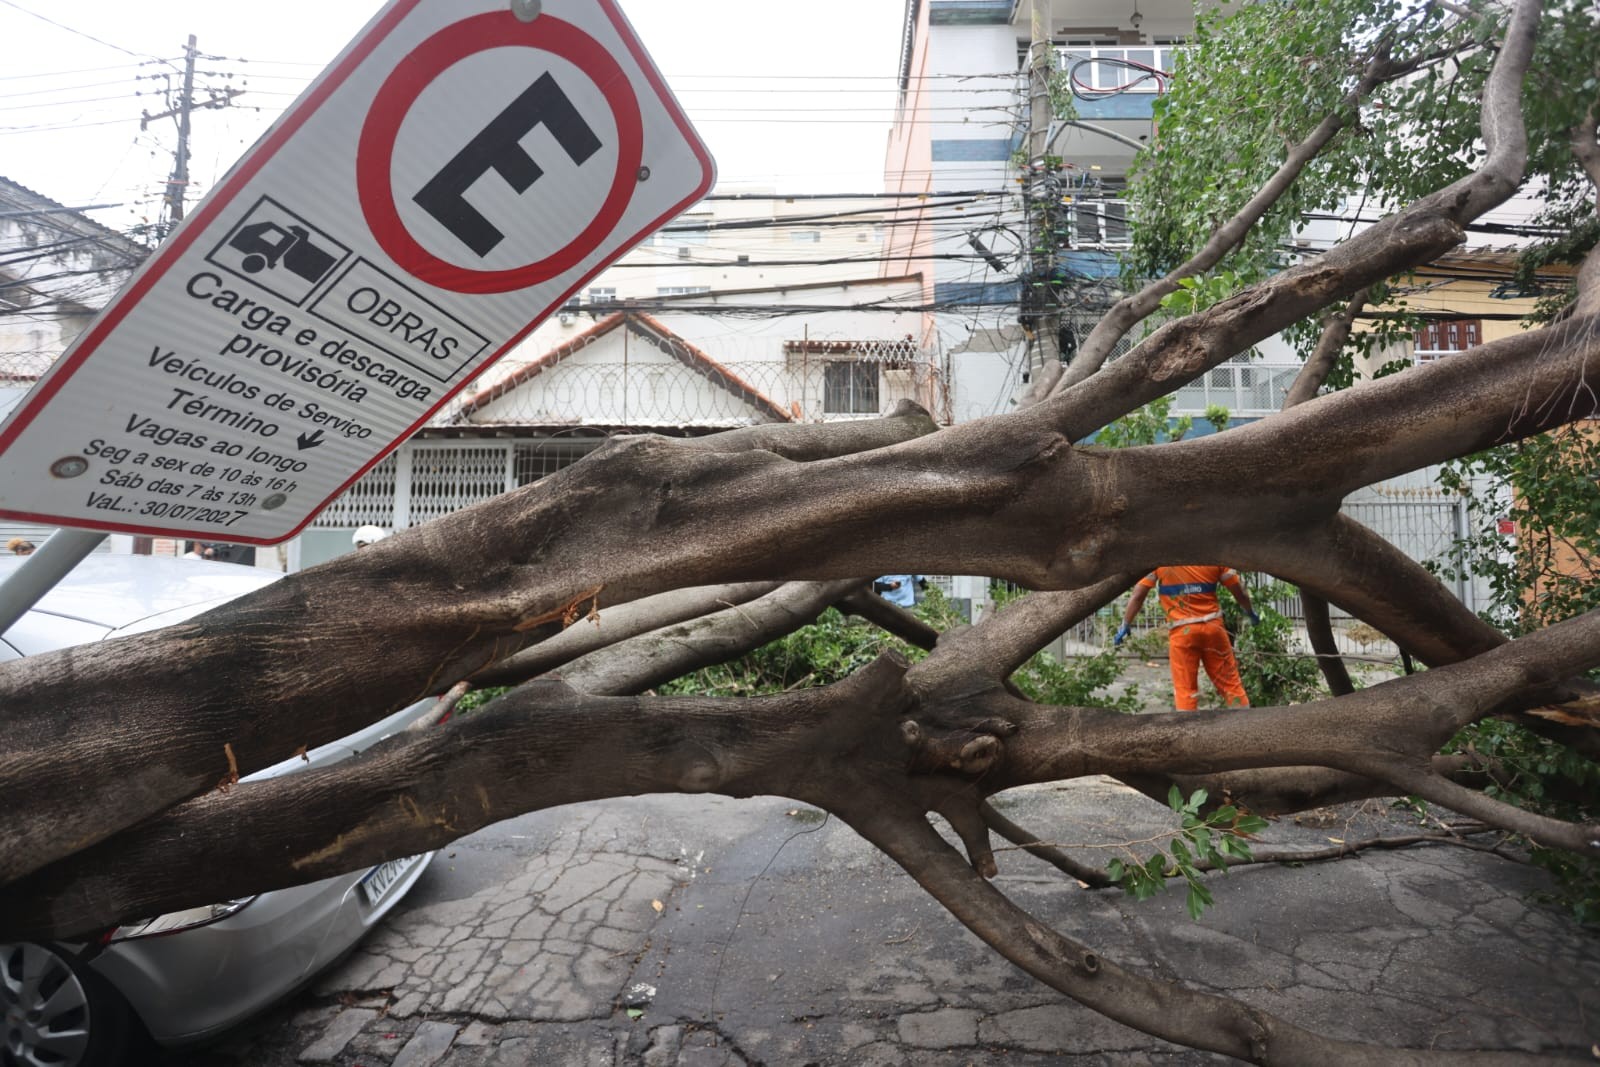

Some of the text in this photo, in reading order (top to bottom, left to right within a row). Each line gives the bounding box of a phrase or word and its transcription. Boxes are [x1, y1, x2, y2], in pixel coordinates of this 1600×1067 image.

[412, 70, 603, 259] E
[185, 271, 432, 402] Carga e descarga
[346, 286, 459, 361] OBRAS
[147, 345, 373, 439] Veículos de Serviço
[218, 333, 368, 404] provisória
[124, 413, 308, 473] Vagas ao longo
[165, 387, 280, 438] Término
[82, 438, 298, 493] Seg a sex de 10 às 16 h
[99, 468, 257, 507] Sáb das 7 às 13h
[139, 500, 249, 527] 30/07/2027
